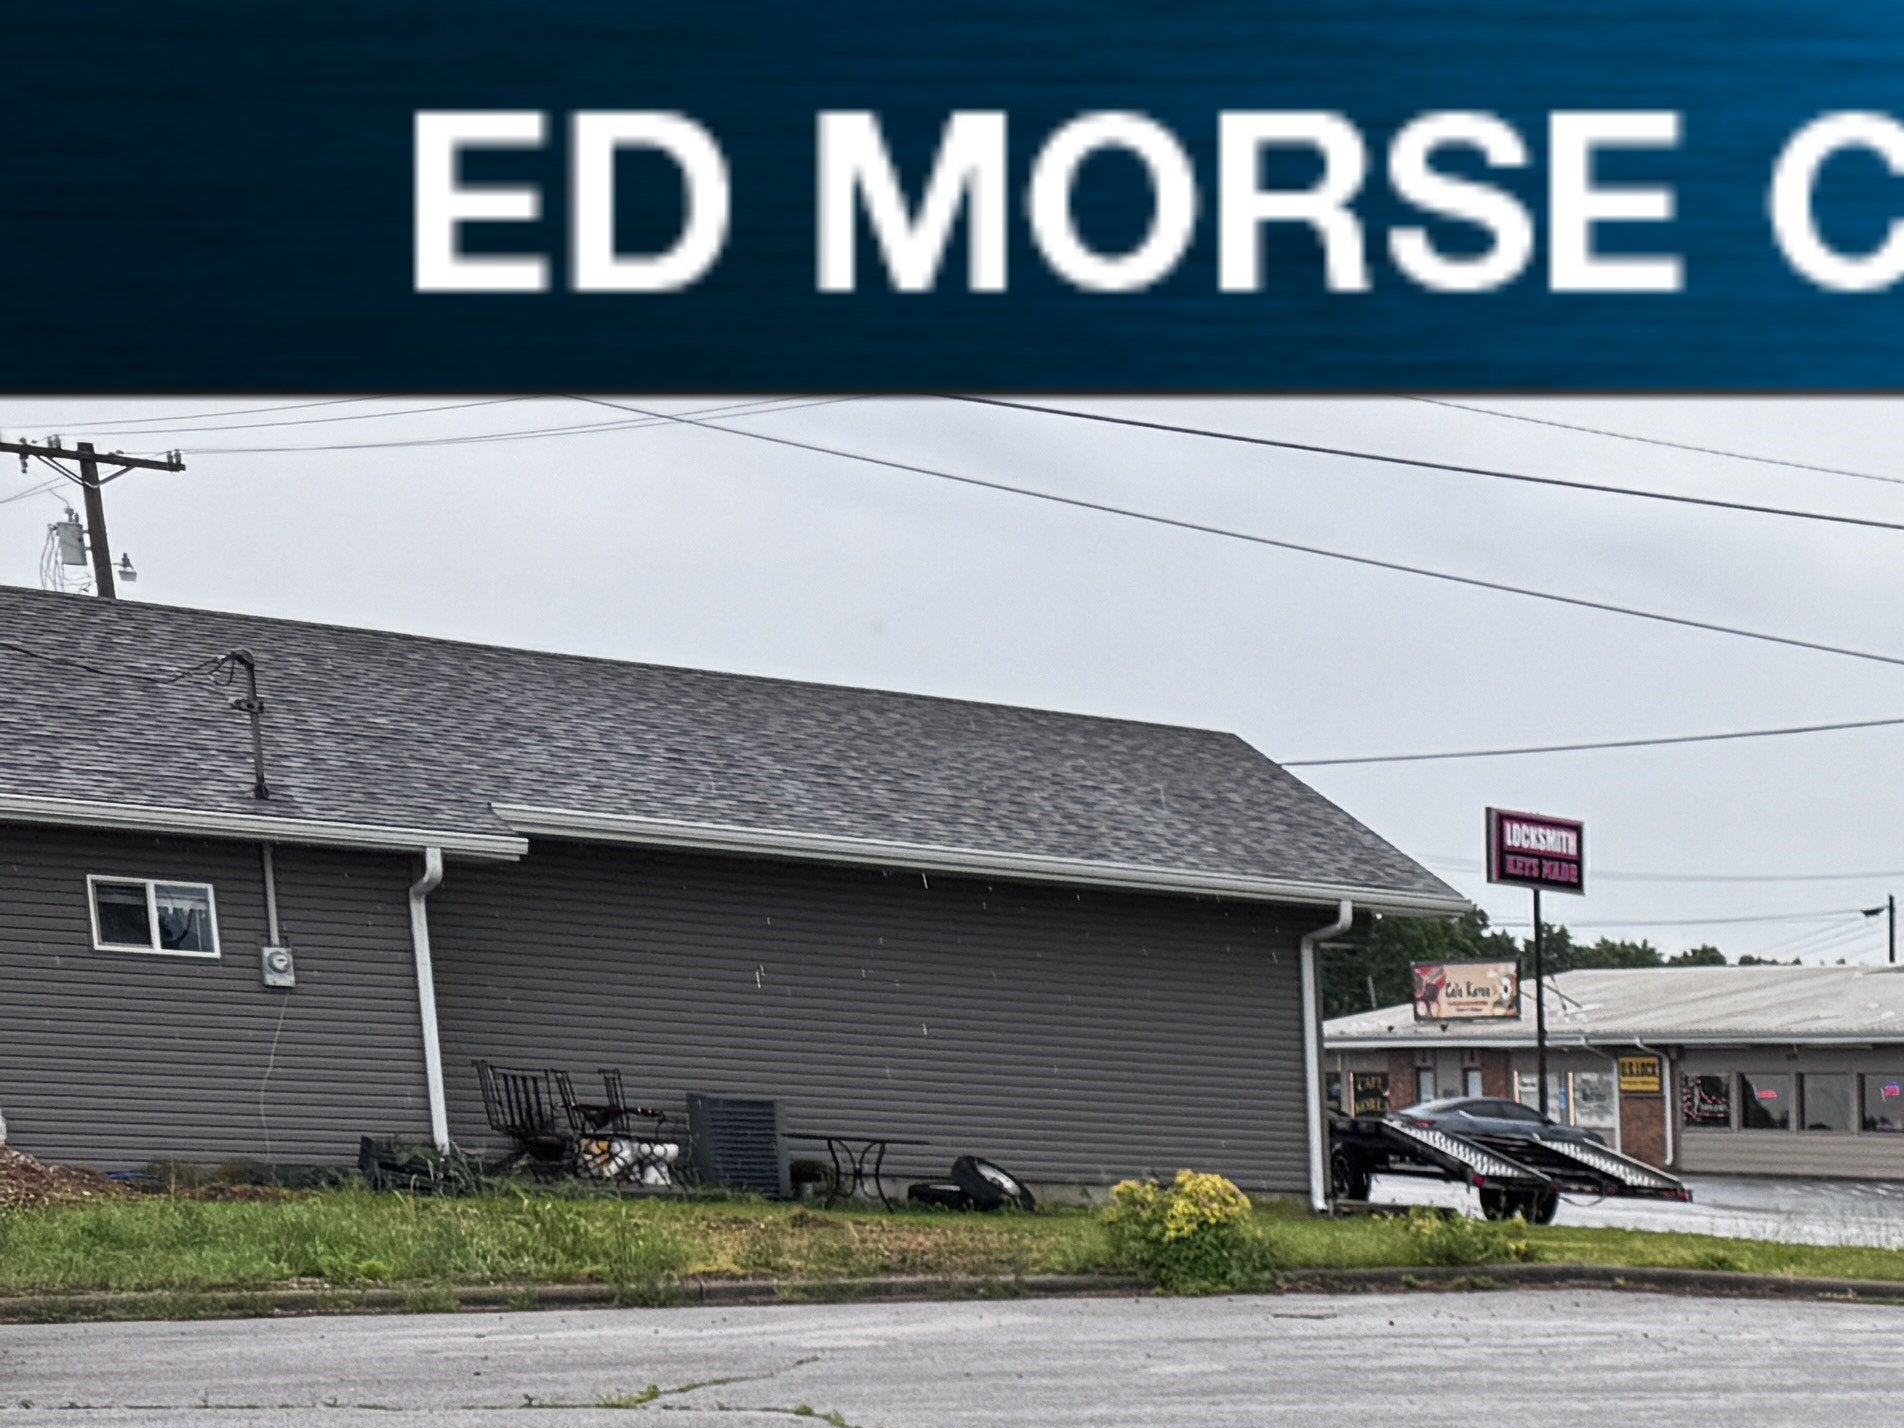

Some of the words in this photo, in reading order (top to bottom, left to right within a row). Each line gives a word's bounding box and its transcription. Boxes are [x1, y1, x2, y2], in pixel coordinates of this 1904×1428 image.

[1504, 821, 1577, 856] LOCKSMITH
[1505, 856, 1540, 878] KEYS
[1541, 860, 1578, 883] MADE
